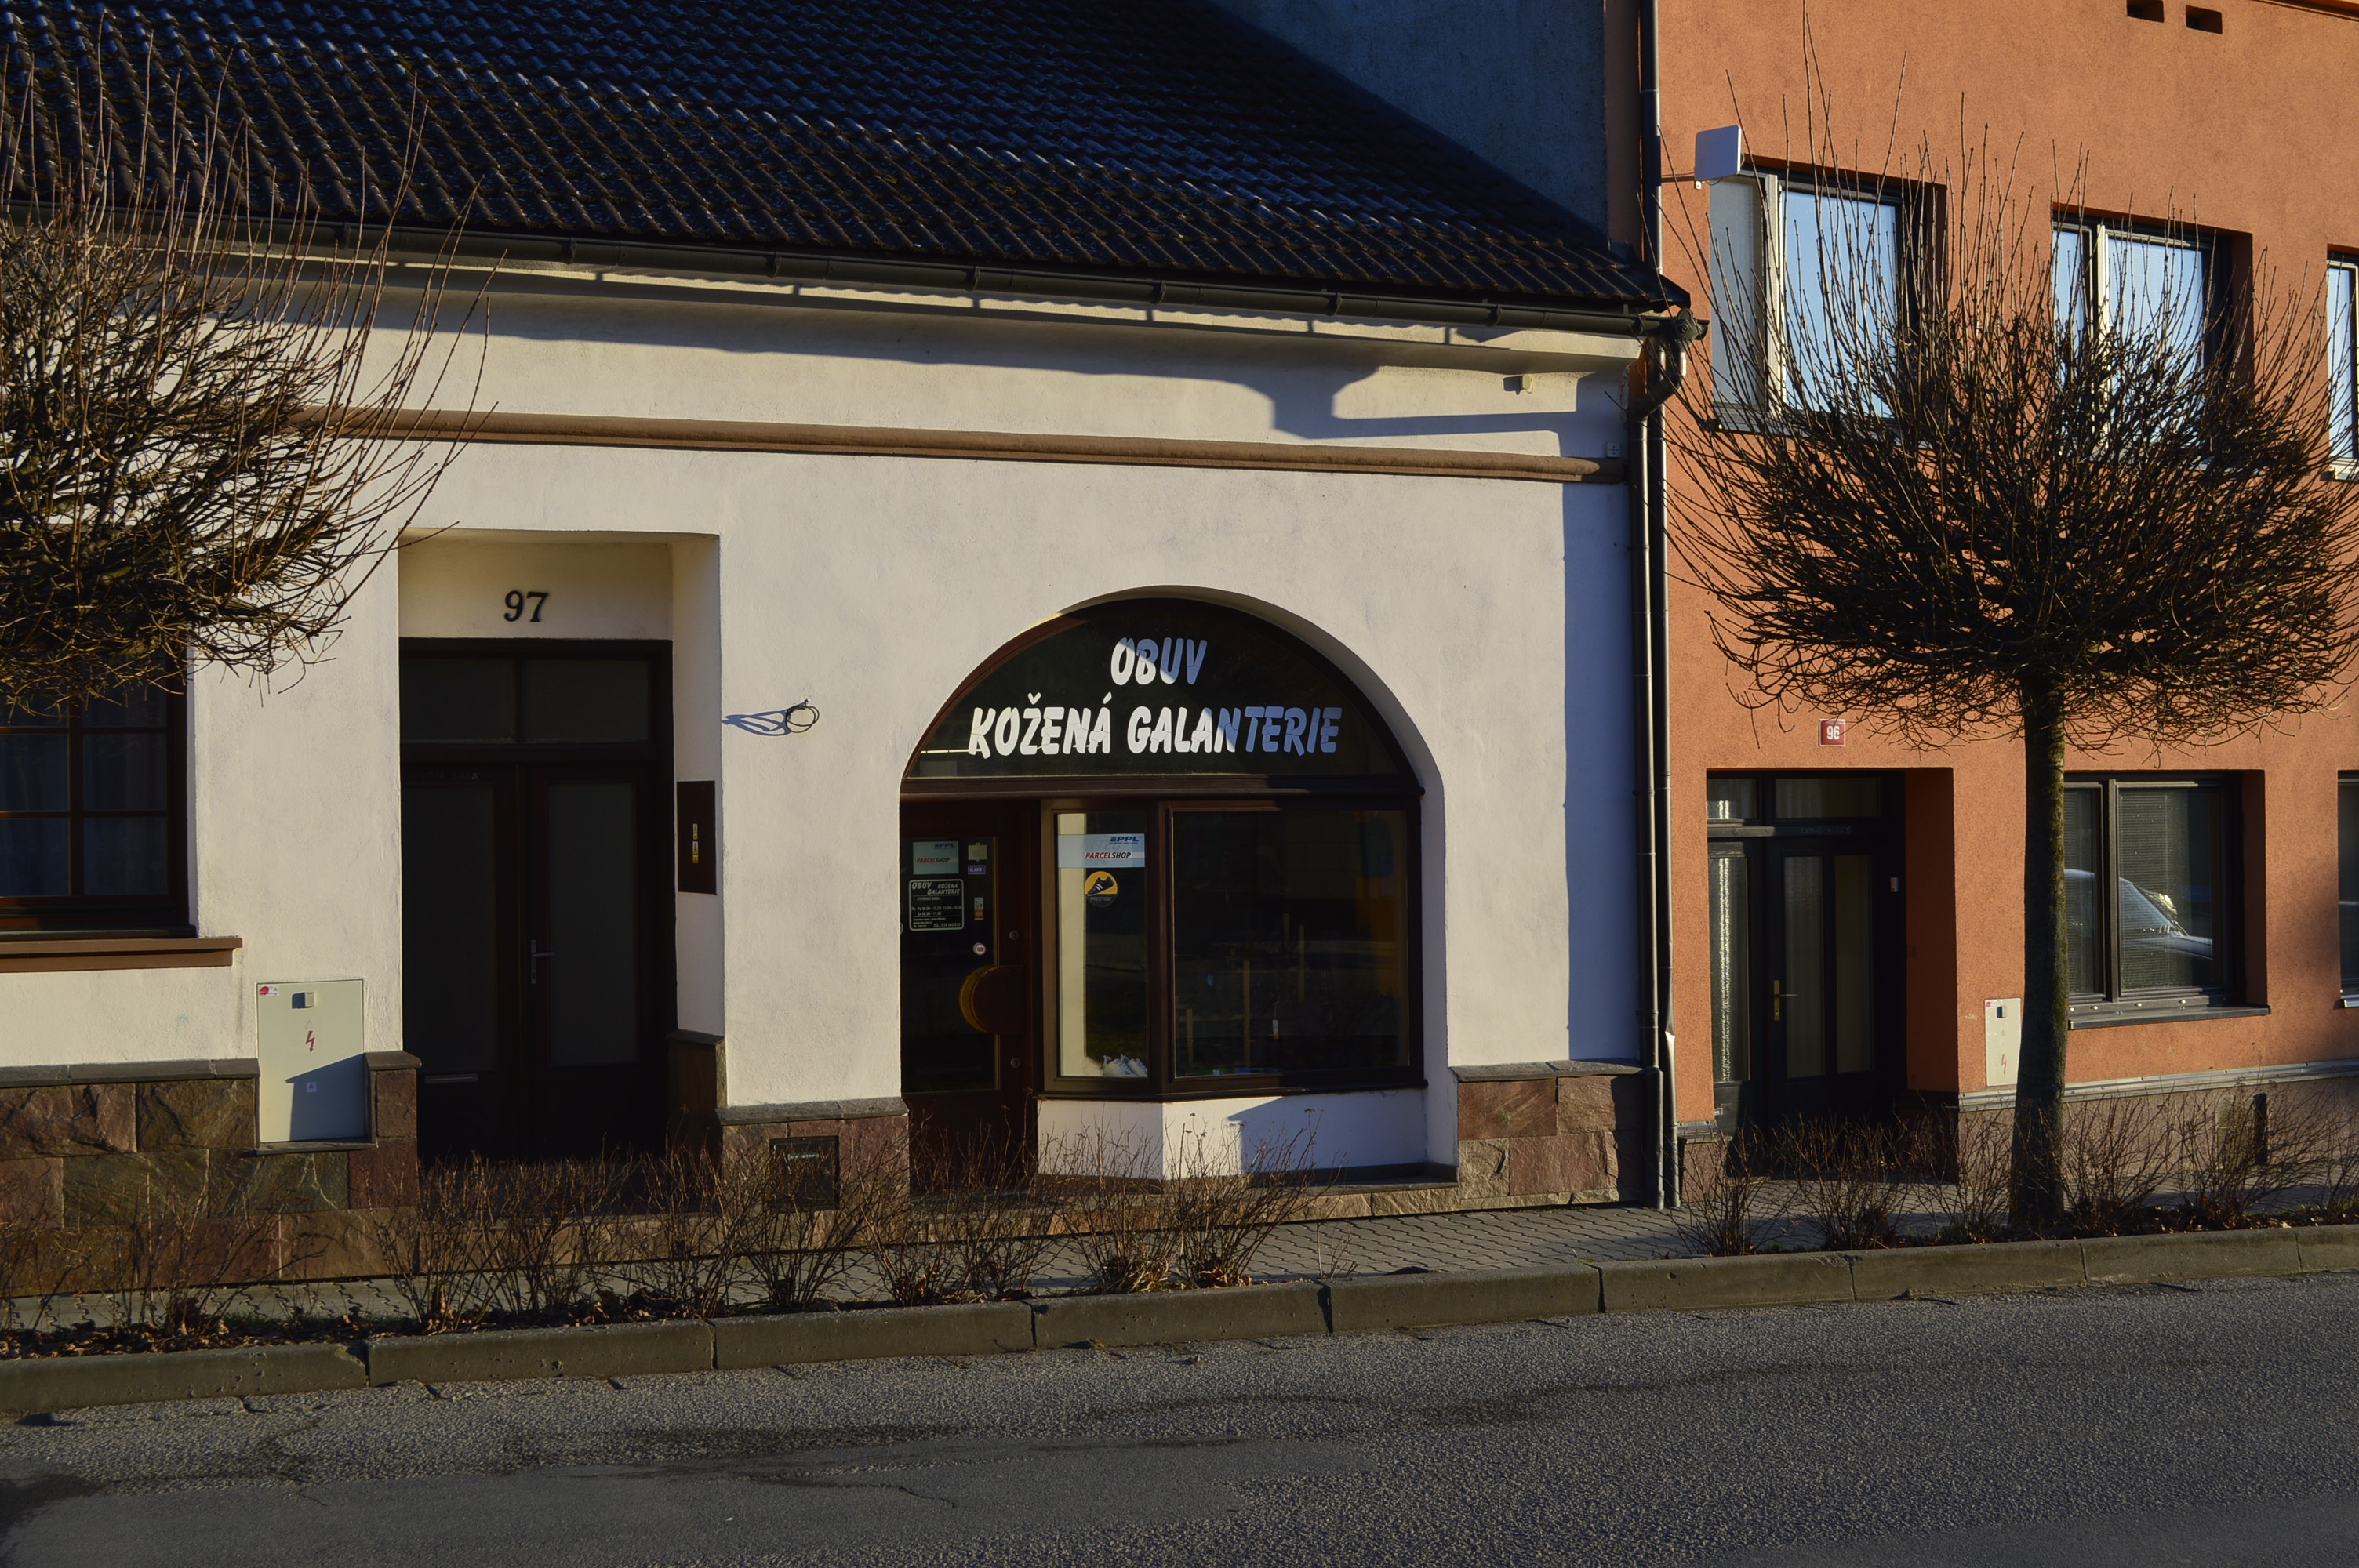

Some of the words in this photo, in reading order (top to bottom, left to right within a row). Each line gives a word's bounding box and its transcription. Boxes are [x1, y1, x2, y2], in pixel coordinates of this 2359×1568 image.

[503, 590, 549, 623] 97
[1110, 637, 1208, 685] OBUV
[968, 691, 1112, 759] KOŽENÁ
[1127, 706, 1343, 756] GALANTERIE
[1826, 725, 1840, 740] 96
